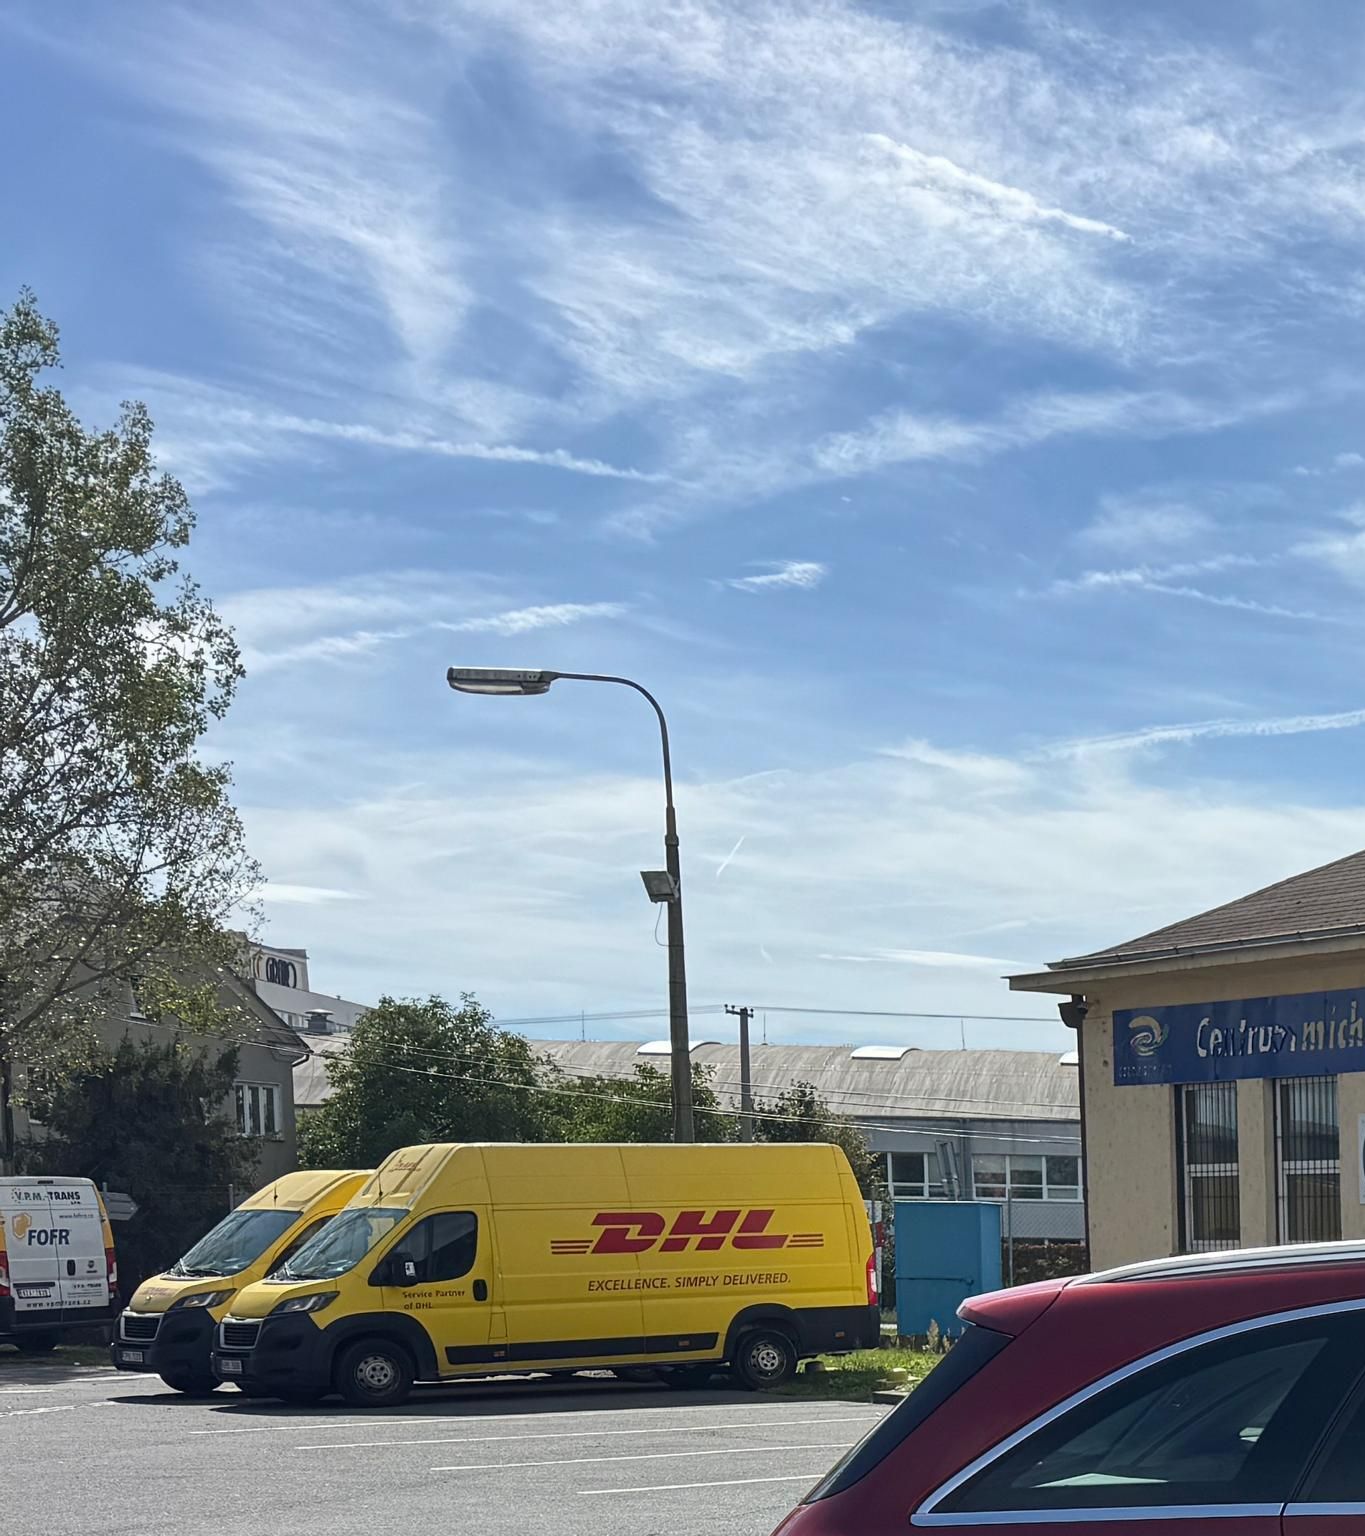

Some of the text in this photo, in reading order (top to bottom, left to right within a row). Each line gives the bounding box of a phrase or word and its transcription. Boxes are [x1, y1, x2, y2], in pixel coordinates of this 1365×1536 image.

[28, 1229, 70, 1246] FOFR
[591, 1209, 789, 1254] DHL
[588, 1272, 791, 1292] EXCELLENCE. SIMPLY DELIVERED.
[402, 1290, 465, 1299] Service Partner
[403, 1302, 413, 1310] of
